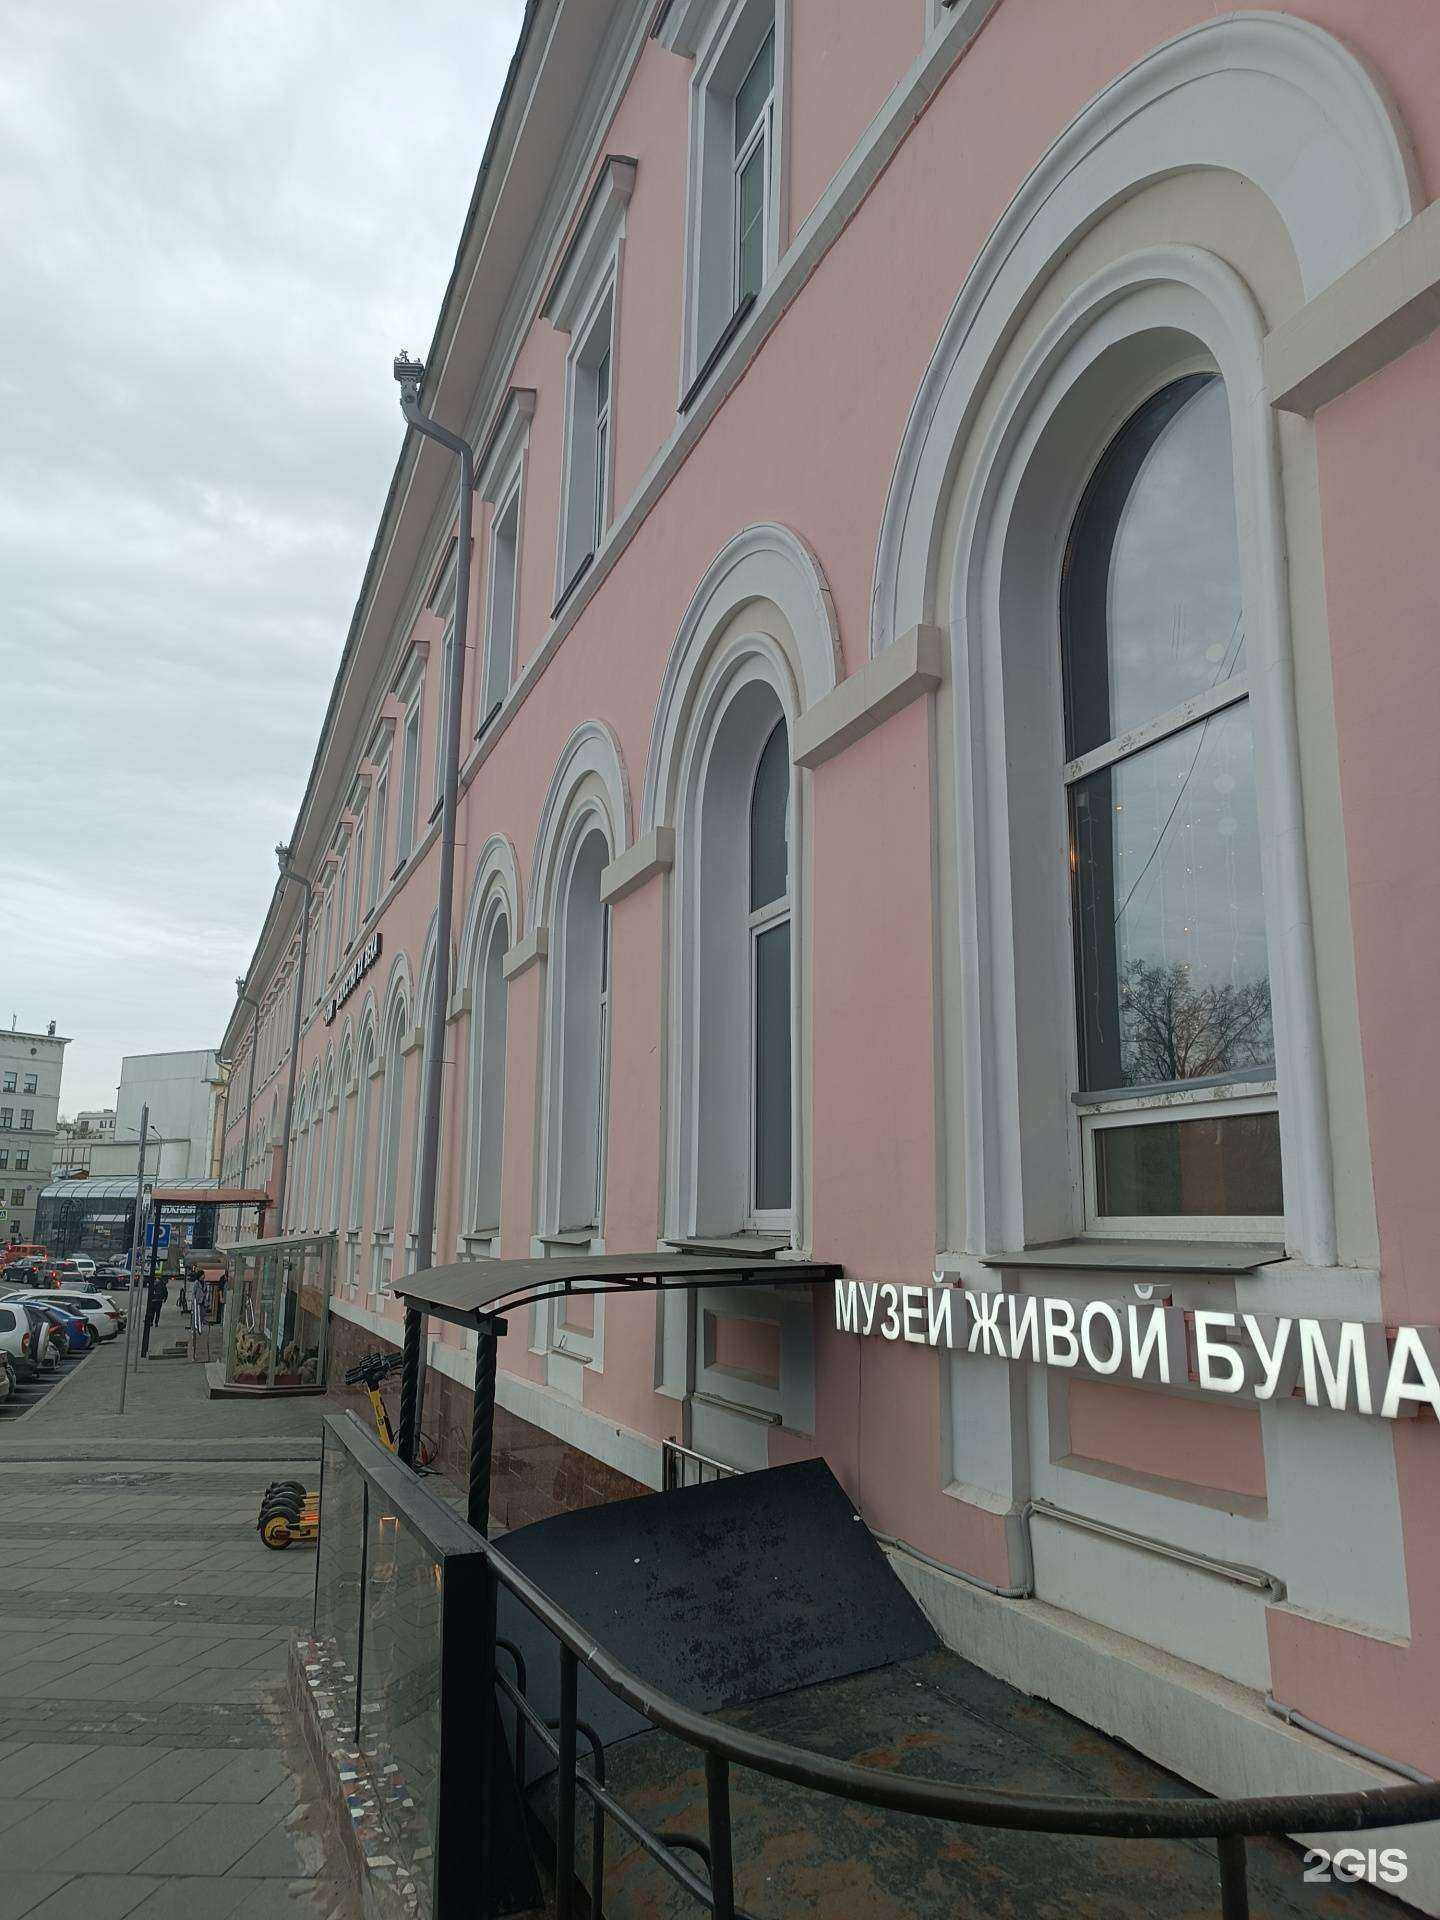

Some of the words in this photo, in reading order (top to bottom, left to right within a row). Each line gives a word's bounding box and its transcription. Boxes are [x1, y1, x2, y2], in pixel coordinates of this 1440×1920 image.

[834, 1271, 953, 1349] МУЗЕЙ
[965, 1283, 1171, 1385] ЖИВОЙ
[1194, 1310, 1440, 1425] БУМА
